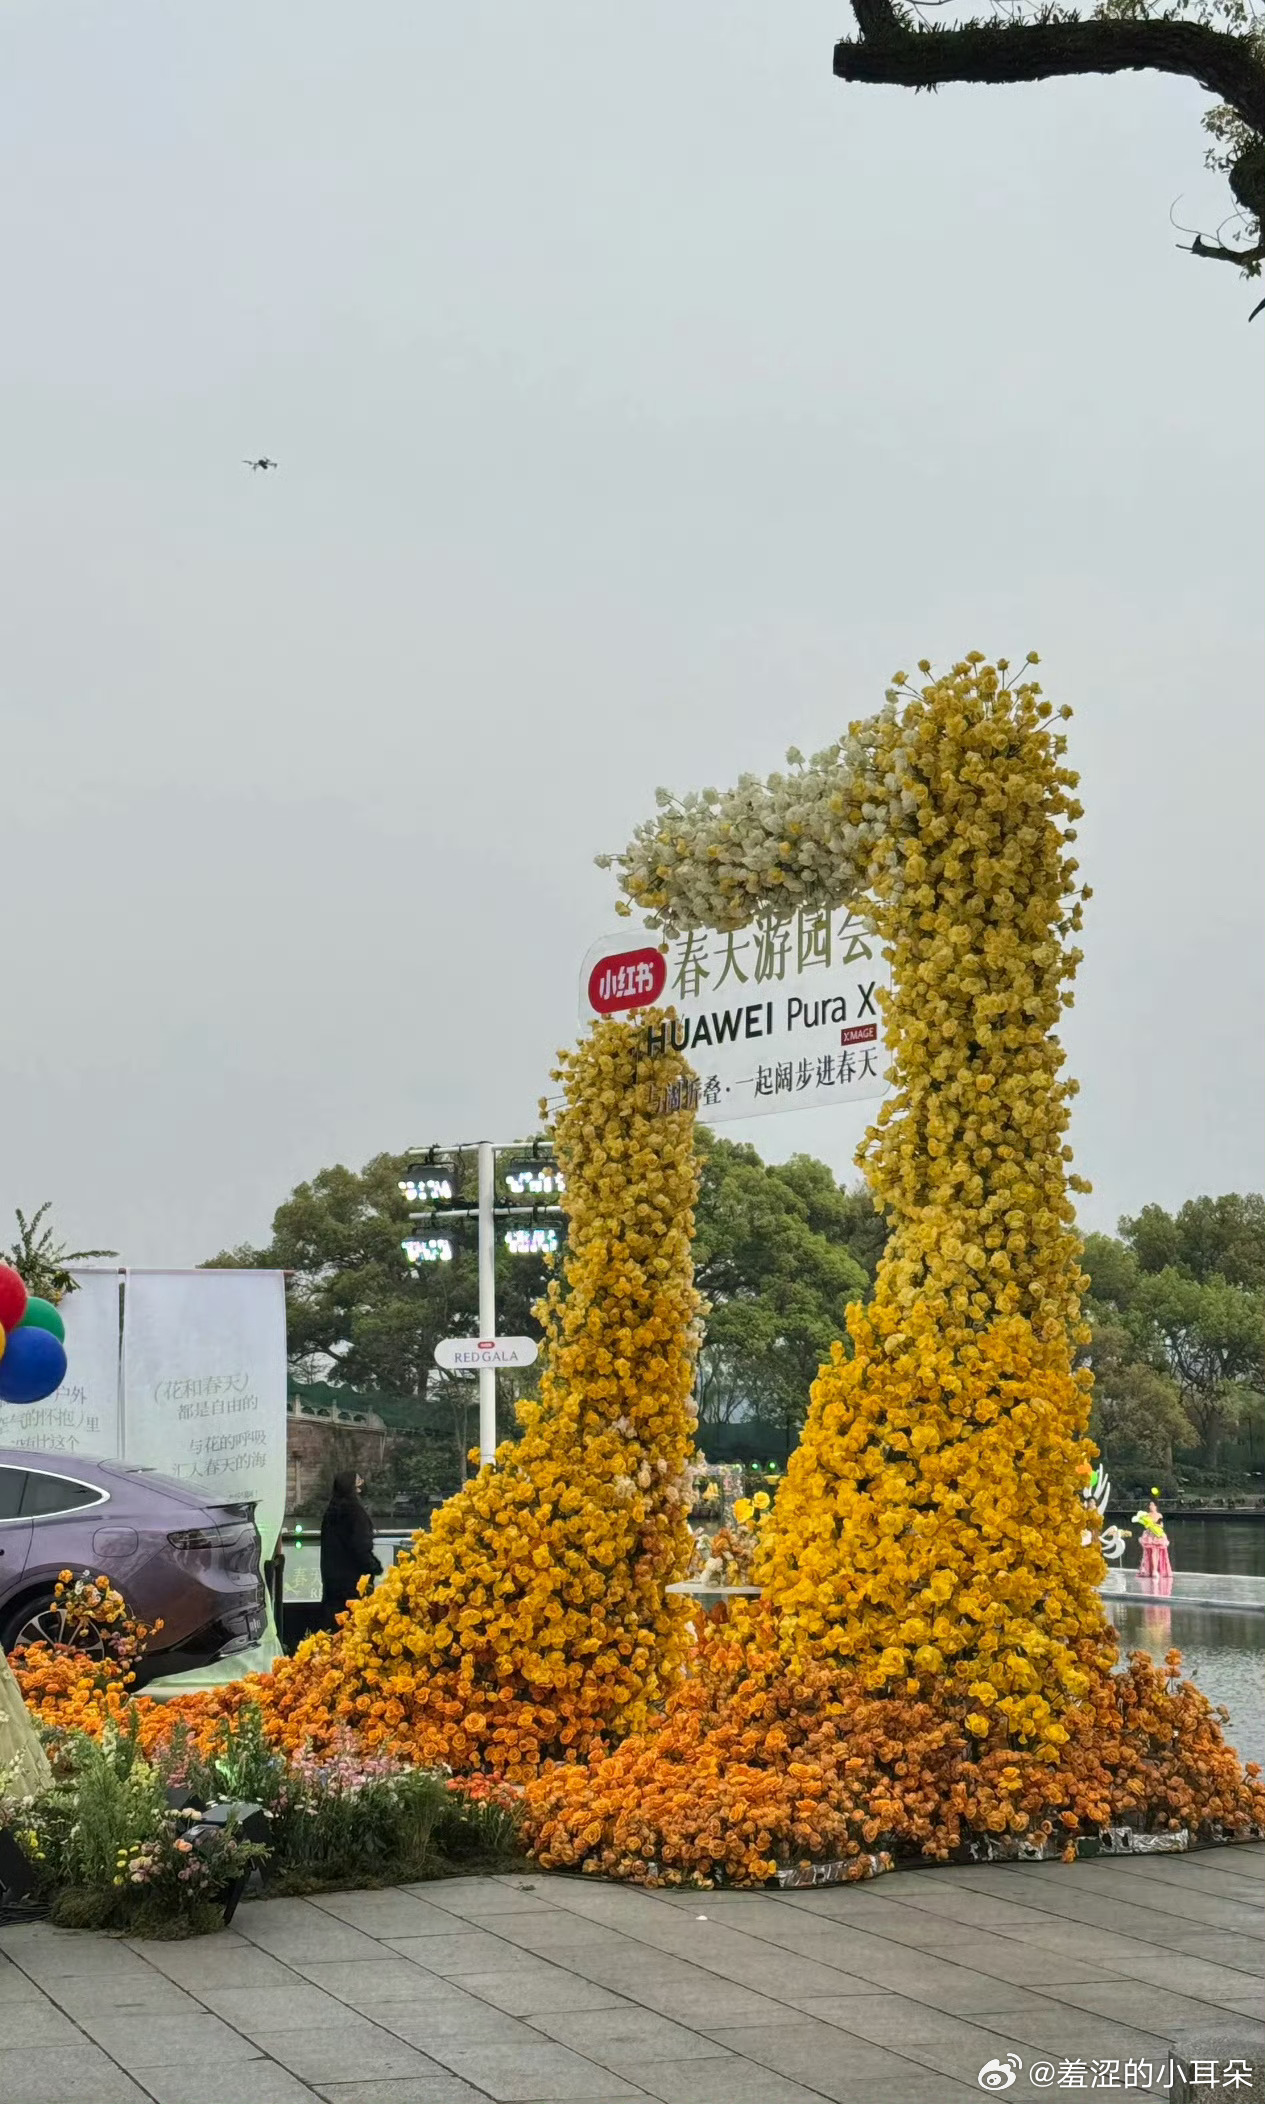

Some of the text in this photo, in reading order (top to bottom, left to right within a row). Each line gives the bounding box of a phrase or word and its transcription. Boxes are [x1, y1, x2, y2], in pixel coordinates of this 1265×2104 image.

[672, 907, 873, 1000] 春天游园会
[599, 961, 654, 1000] 小红书
[646, 981, 877, 1057] HUAWEI Pura X
[843, 1026, 874, 1042] XMAGE
[177, 1395, 258, 1420] 都是自由的
[189, 1429, 267, 1455] 与花的呼吸
